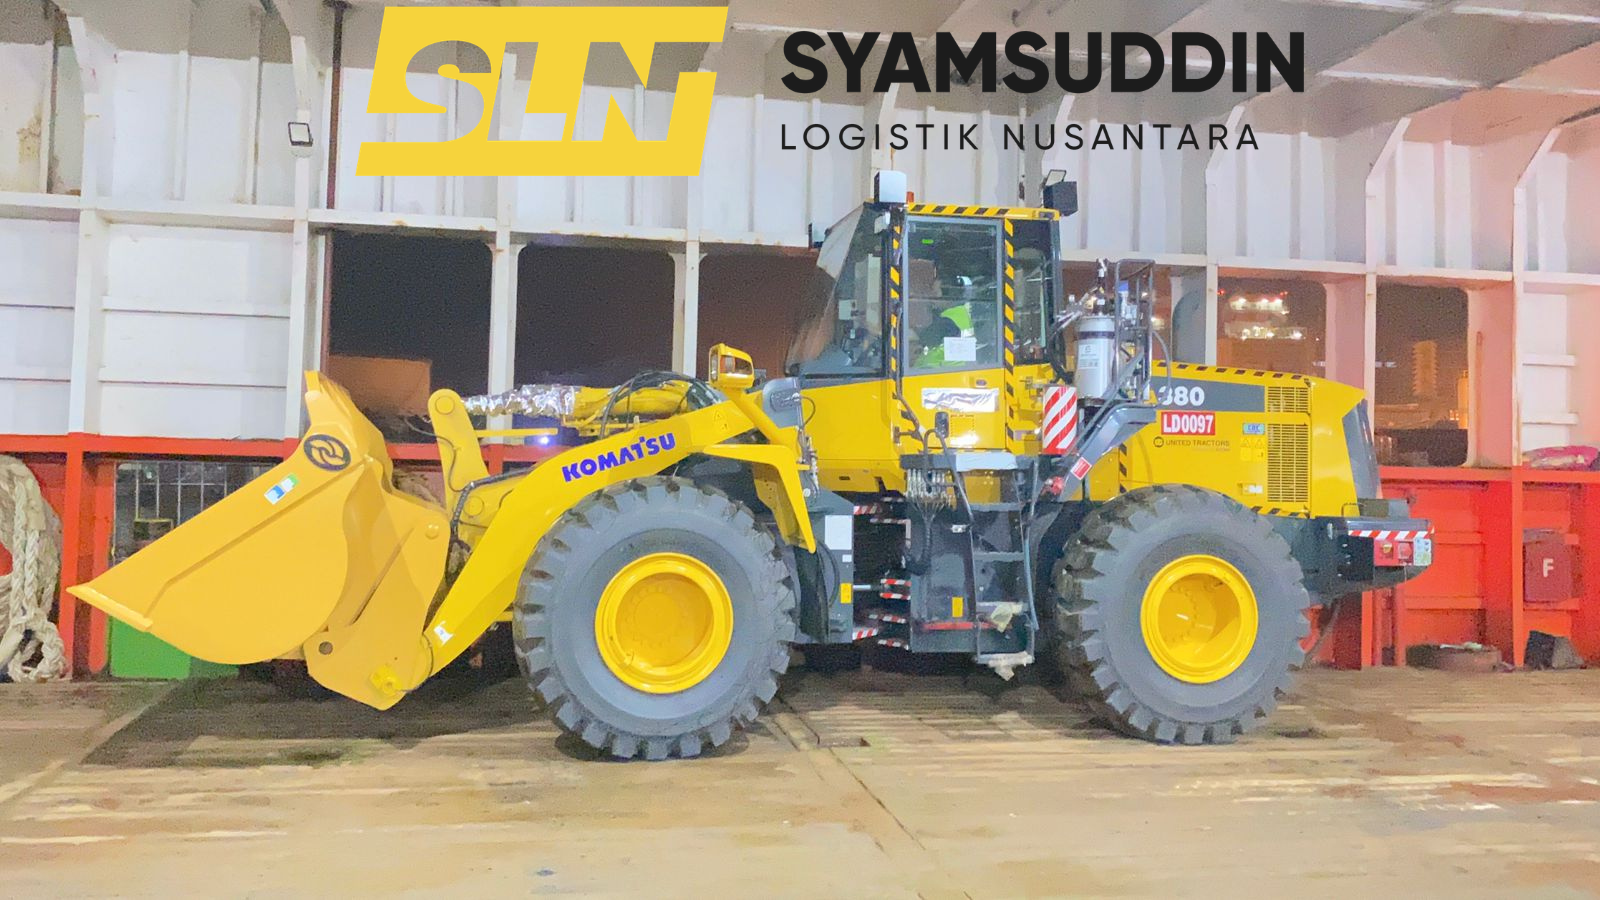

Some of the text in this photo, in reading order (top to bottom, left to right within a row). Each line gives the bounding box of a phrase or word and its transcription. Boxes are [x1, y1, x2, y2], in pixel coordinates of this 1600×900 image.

[1159, 386, 1205, 406] 380
[1163, 414, 1214, 433] LD0097
[1166, 439, 1230, 447] UNITED TRACTORS
[562, 433, 675, 482] KOMATSU
[1543, 558, 1554, 577] F
